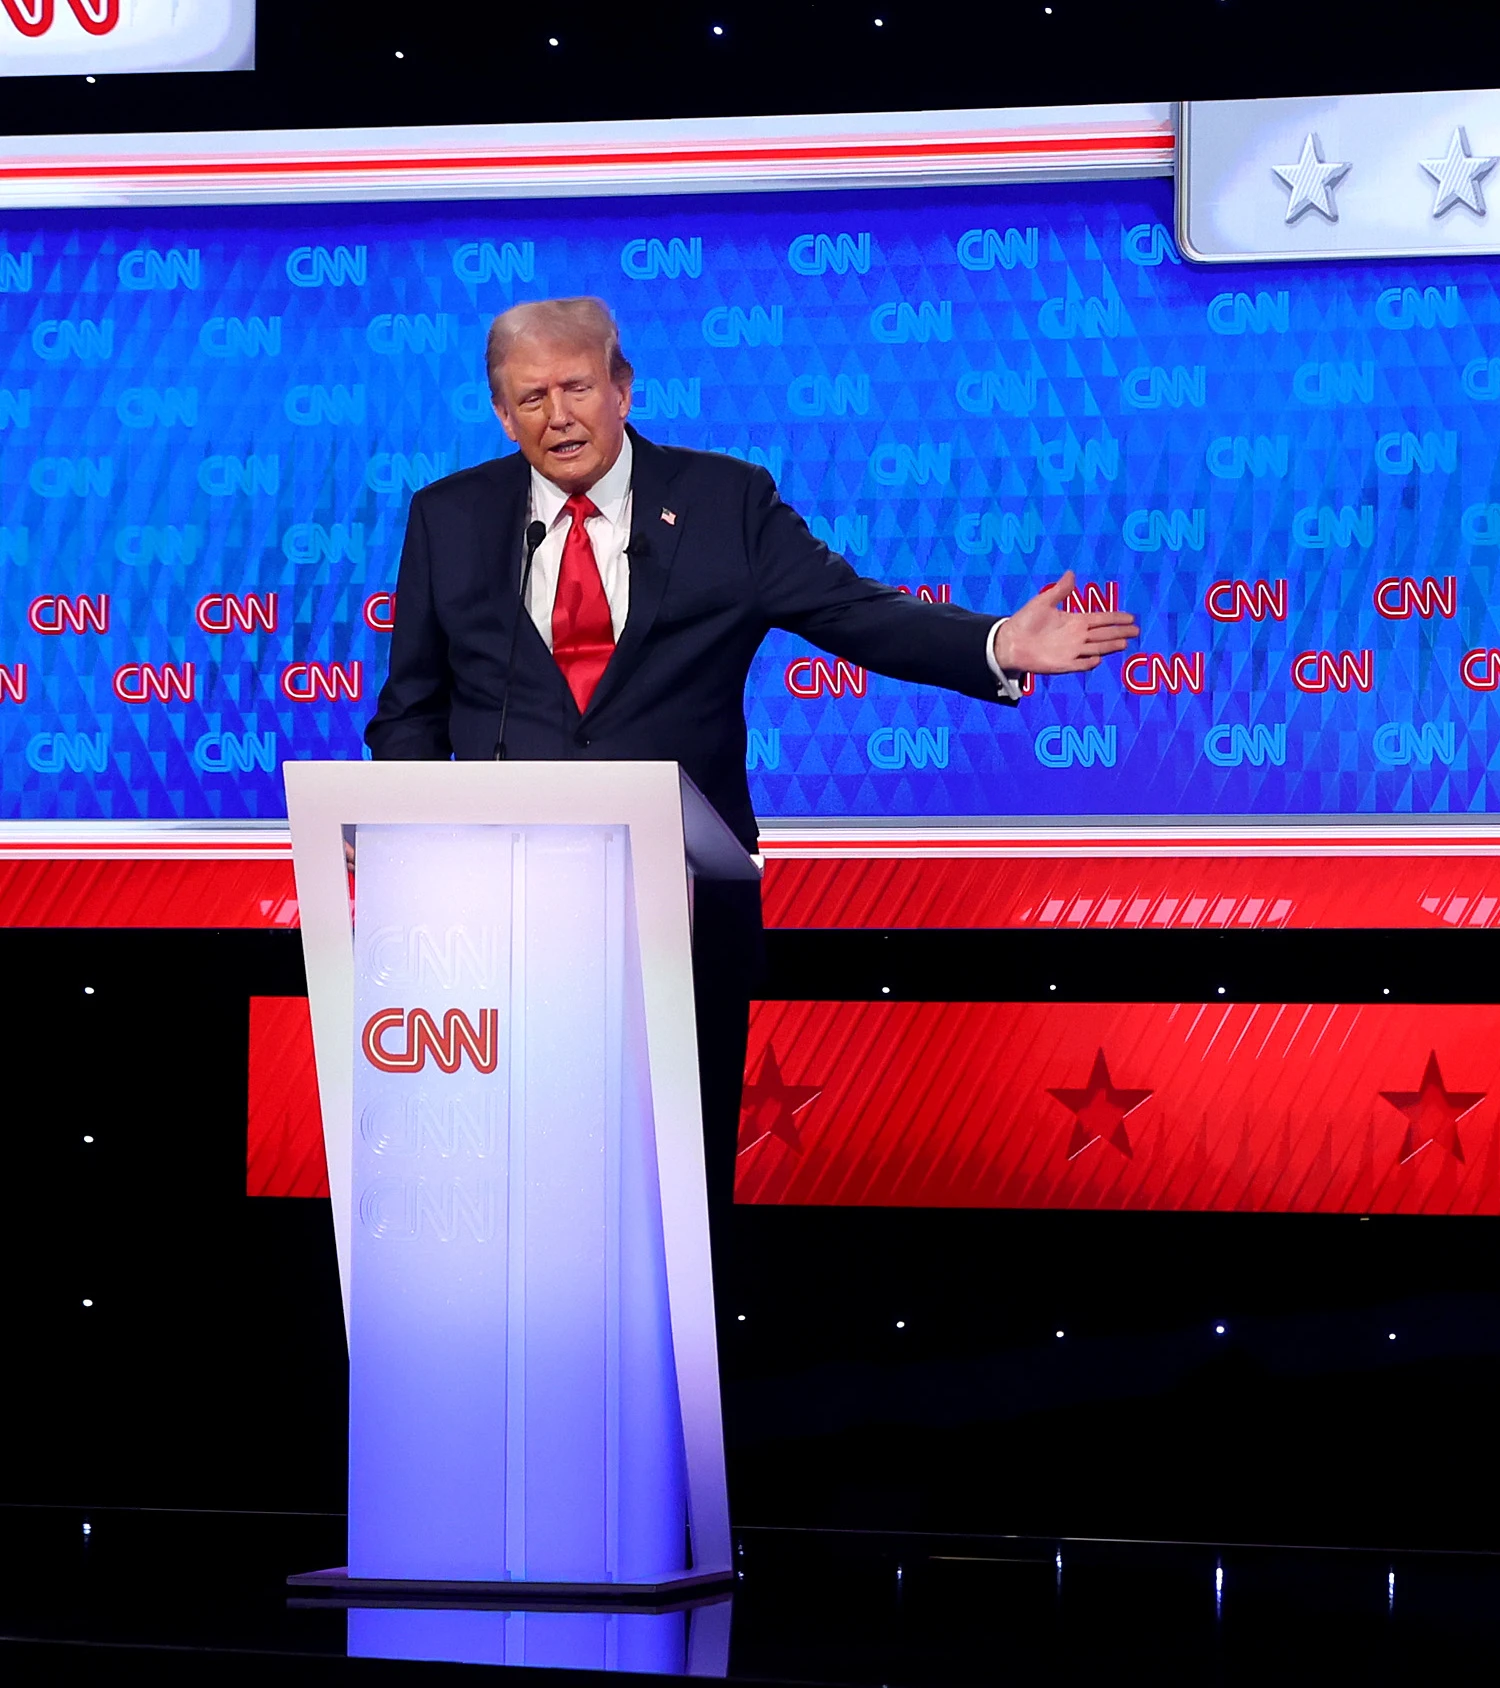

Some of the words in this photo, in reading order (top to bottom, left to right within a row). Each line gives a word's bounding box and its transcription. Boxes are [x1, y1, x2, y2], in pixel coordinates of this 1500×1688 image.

[117, 249, 199, 290] CNN
[286, 246, 366, 287] CNN
[453, 241, 534, 283] CNN
[621, 237, 701, 279] CNN
[788, 232, 870, 275] CNN
[957, 227, 1038, 270] CNN
[702, 305, 782, 346] CNN
[871, 301, 952, 342] CNN
[1038, 297, 1120, 339] CNN
[1207, 291, 1289, 334] CNN
[1376, 286, 1458, 329] CNN
[32, 319, 113, 360] CNN
[202, 316, 281, 357] CNN
[367, 313, 447, 354] CNN
[787, 374, 869, 416] CNN
[956, 370, 1037, 413] CNN
[1122, 366, 1206, 408] CNN
[1293, 362, 1374, 404] CNN
[117, 387, 198, 427] CNN
[285, 384, 365, 425] CNN
[871, 443, 951, 485] CNN
[1037, 439, 1119, 482] CNN
[1206, 435, 1288, 478] CNN
[1375, 431, 1457, 475] CNN
[30, 457, 112, 497] CNN
[201, 454, 280, 496] CNN
[115, 525, 196, 565] CNN
[283, 522, 364, 564] CNN
[806, 515, 868, 556] NN
[956, 511, 1036, 554] CNN
[1122, 508, 1205, 552] CNN
[1292, 505, 1373, 548] CNN
[28, 593, 108, 634] CNN
[196, 592, 277, 633] CNN
[1206, 579, 1286, 621] CNN
[1375, 576, 1456, 620] CNN
[114, 662, 194, 703] CNN
[281, 661, 361, 703] CNN
[785, 656, 866, 698] CNN
[1121, 651, 1204, 694] CNN
[1291, 649, 1372, 693] CNN
[27, 732, 108, 772] CNN
[195, 731, 276, 772] CNN
[867, 726, 949, 769] CNN
[1035, 724, 1116, 767] CNN
[1204, 722, 1286, 765] CNN
[1373, 721, 1455, 765] CNN
[362, 1008, 498, 1074] CNN
